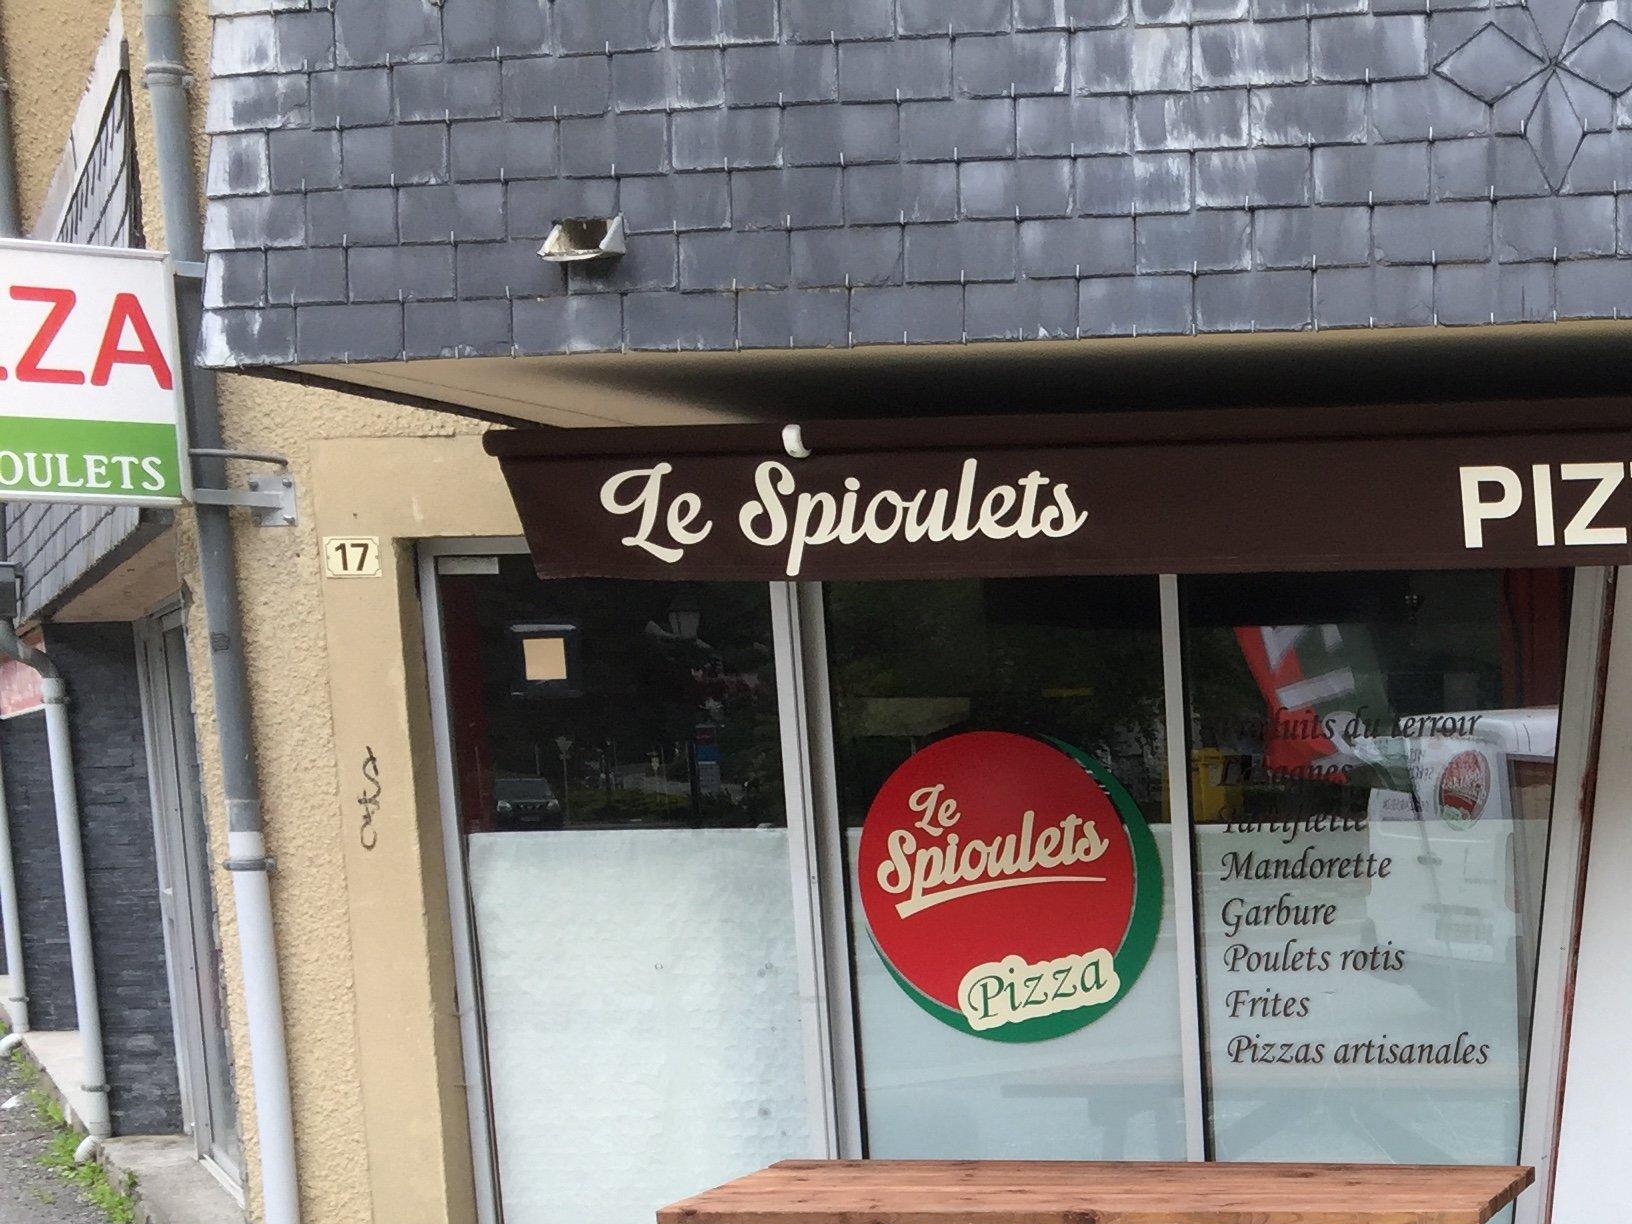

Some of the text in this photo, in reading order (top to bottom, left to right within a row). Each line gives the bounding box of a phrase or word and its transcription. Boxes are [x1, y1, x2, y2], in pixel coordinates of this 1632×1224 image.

[0, 286, 173, 390] ZA
[0, 451, 166, 491] OULETS
[600, 458, 1089, 577] Le Spioulets
[334, 542, 370, 572] 17
[1343, 705, 1378, 739] du
[1391, 712, 1482, 739] terroir
[908, 784, 961, 836] Le
[876, 810, 1109, 905] Spioulets
[1220, 846, 1392, 882] Mandorette
[1222, 893, 1337, 937] Garbure
[1224, 939, 1406, 973] Poulets rotis
[968, 957, 1108, 1021] Pizza
[1225, 987, 1311, 1018] Frites
[1227, 1031, 1491, 1065] Pizzas artisanales
